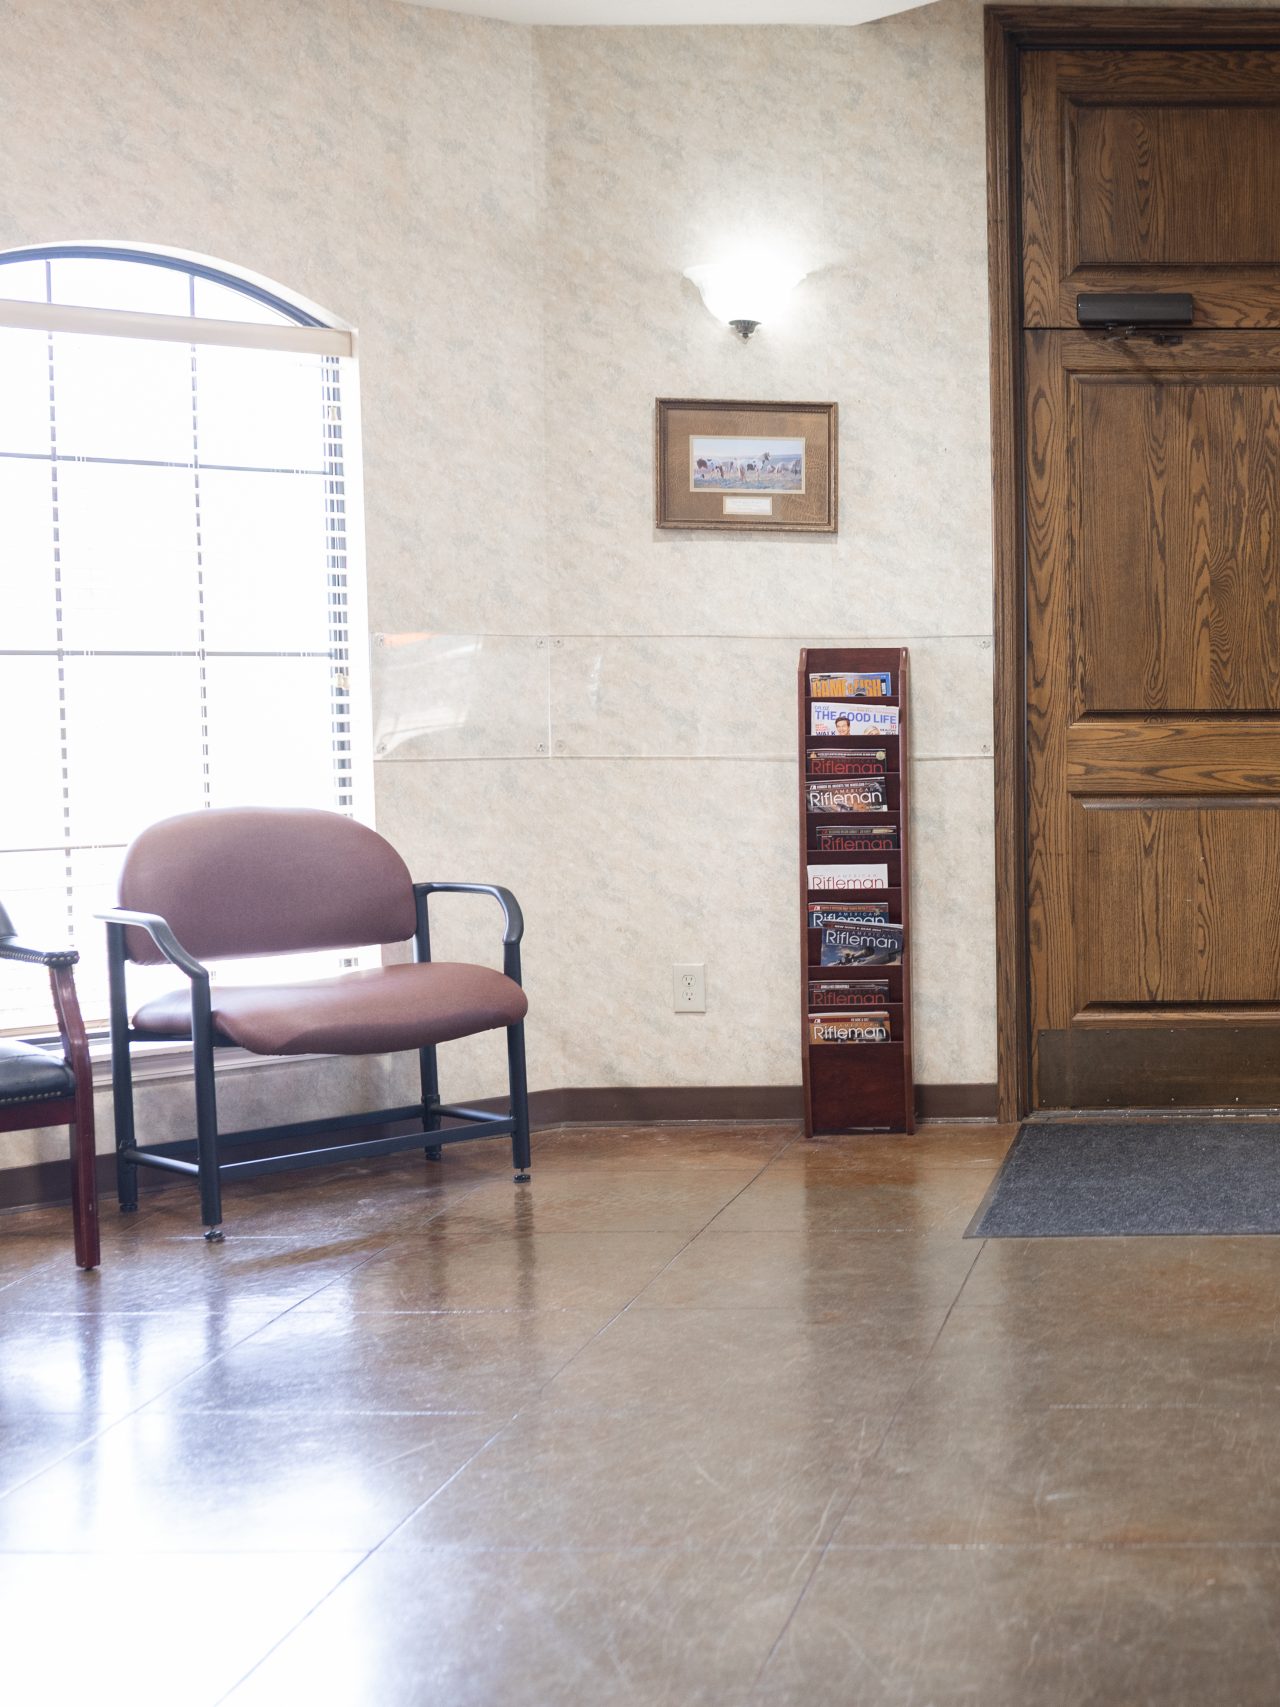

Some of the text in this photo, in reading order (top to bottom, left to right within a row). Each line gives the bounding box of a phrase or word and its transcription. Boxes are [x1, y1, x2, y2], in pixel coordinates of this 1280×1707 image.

[815, 710, 837, 721] THE
[839, 711, 871, 723] GOOD
[873, 714, 896, 725] LIFE
[811, 760, 884, 774] Rifleman
[809, 791, 882, 807] Rifleman
[820, 837, 893, 850] Rifleman
[812, 876, 884, 889] Rifleman
[826, 930, 898, 949] Rifleman
[813, 992, 885, 1005] Rifleman
[813, 1026, 887, 1039] Rifleman
